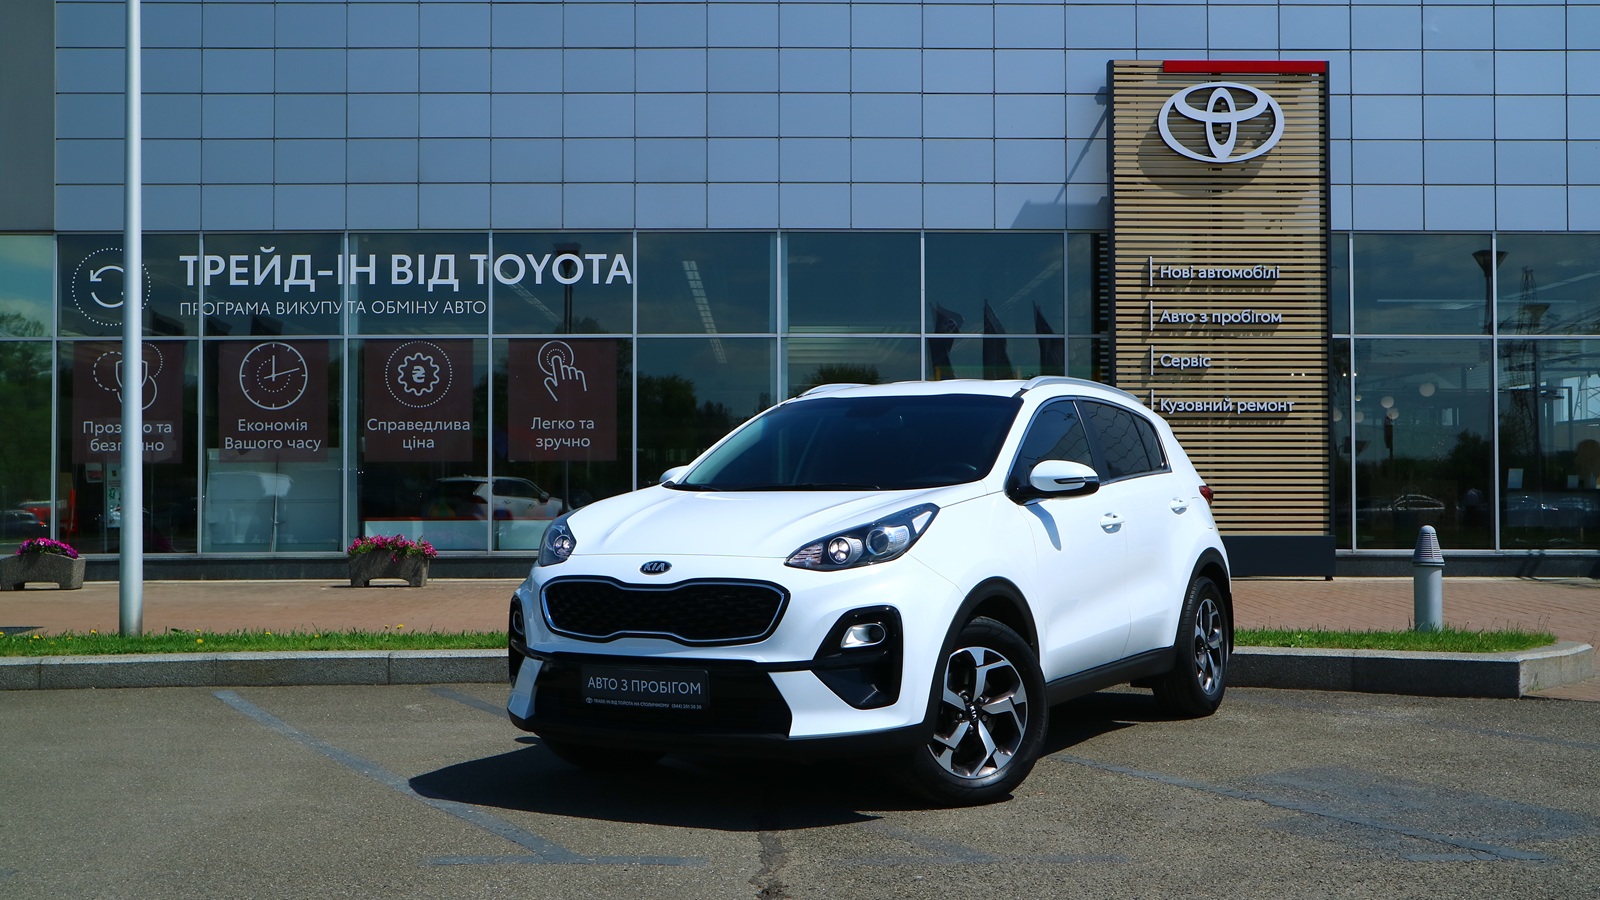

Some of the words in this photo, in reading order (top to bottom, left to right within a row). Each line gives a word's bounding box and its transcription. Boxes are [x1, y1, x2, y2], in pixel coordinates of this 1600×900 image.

[179, 246, 376, 293] ТРЕЙД-ІН
[391, 253, 459, 292] ВІД
[470, 253, 633, 285] TOYOTA
[1160, 265, 1194, 279] Нові
[1198, 265, 1280, 279] автомобілі
[180, 302, 270, 316] ПРОГРАМА
[276, 301, 342, 315] ВИКУПУ
[347, 300, 366, 314] ТА
[371, 300, 438, 315] ОБМІНУ
[443, 300, 486, 314] АВТО
[1160, 310, 1195, 323] Авто
[1199, 315, 1208, 323] з
[1212, 310, 1282, 326] пробігом
[1160, 354, 1211, 370] Сервіс
[1160, 397, 1233, 414] Кузовний
[1237, 401, 1295, 414] ремонт
[83, 421, 152, 436] Прозо
[156, 423, 172, 433] та
[237, 418, 308, 432] Економія
[367, 418, 470, 433] Справедлива
[531, 417, 575, 430] Легко
[579, 420, 595, 430] та
[90, 438, 165, 451] безно
[224, 437, 282, 449] Вашого
[287, 439, 321, 452] часу
[402, 436, 435, 450] ціна
[535, 437, 591, 450] зручно
[644, 562, 664, 571] KIA
[588, 676, 618, 690] АВТО
[631, 680, 701, 694] ПРОБІГОМ
